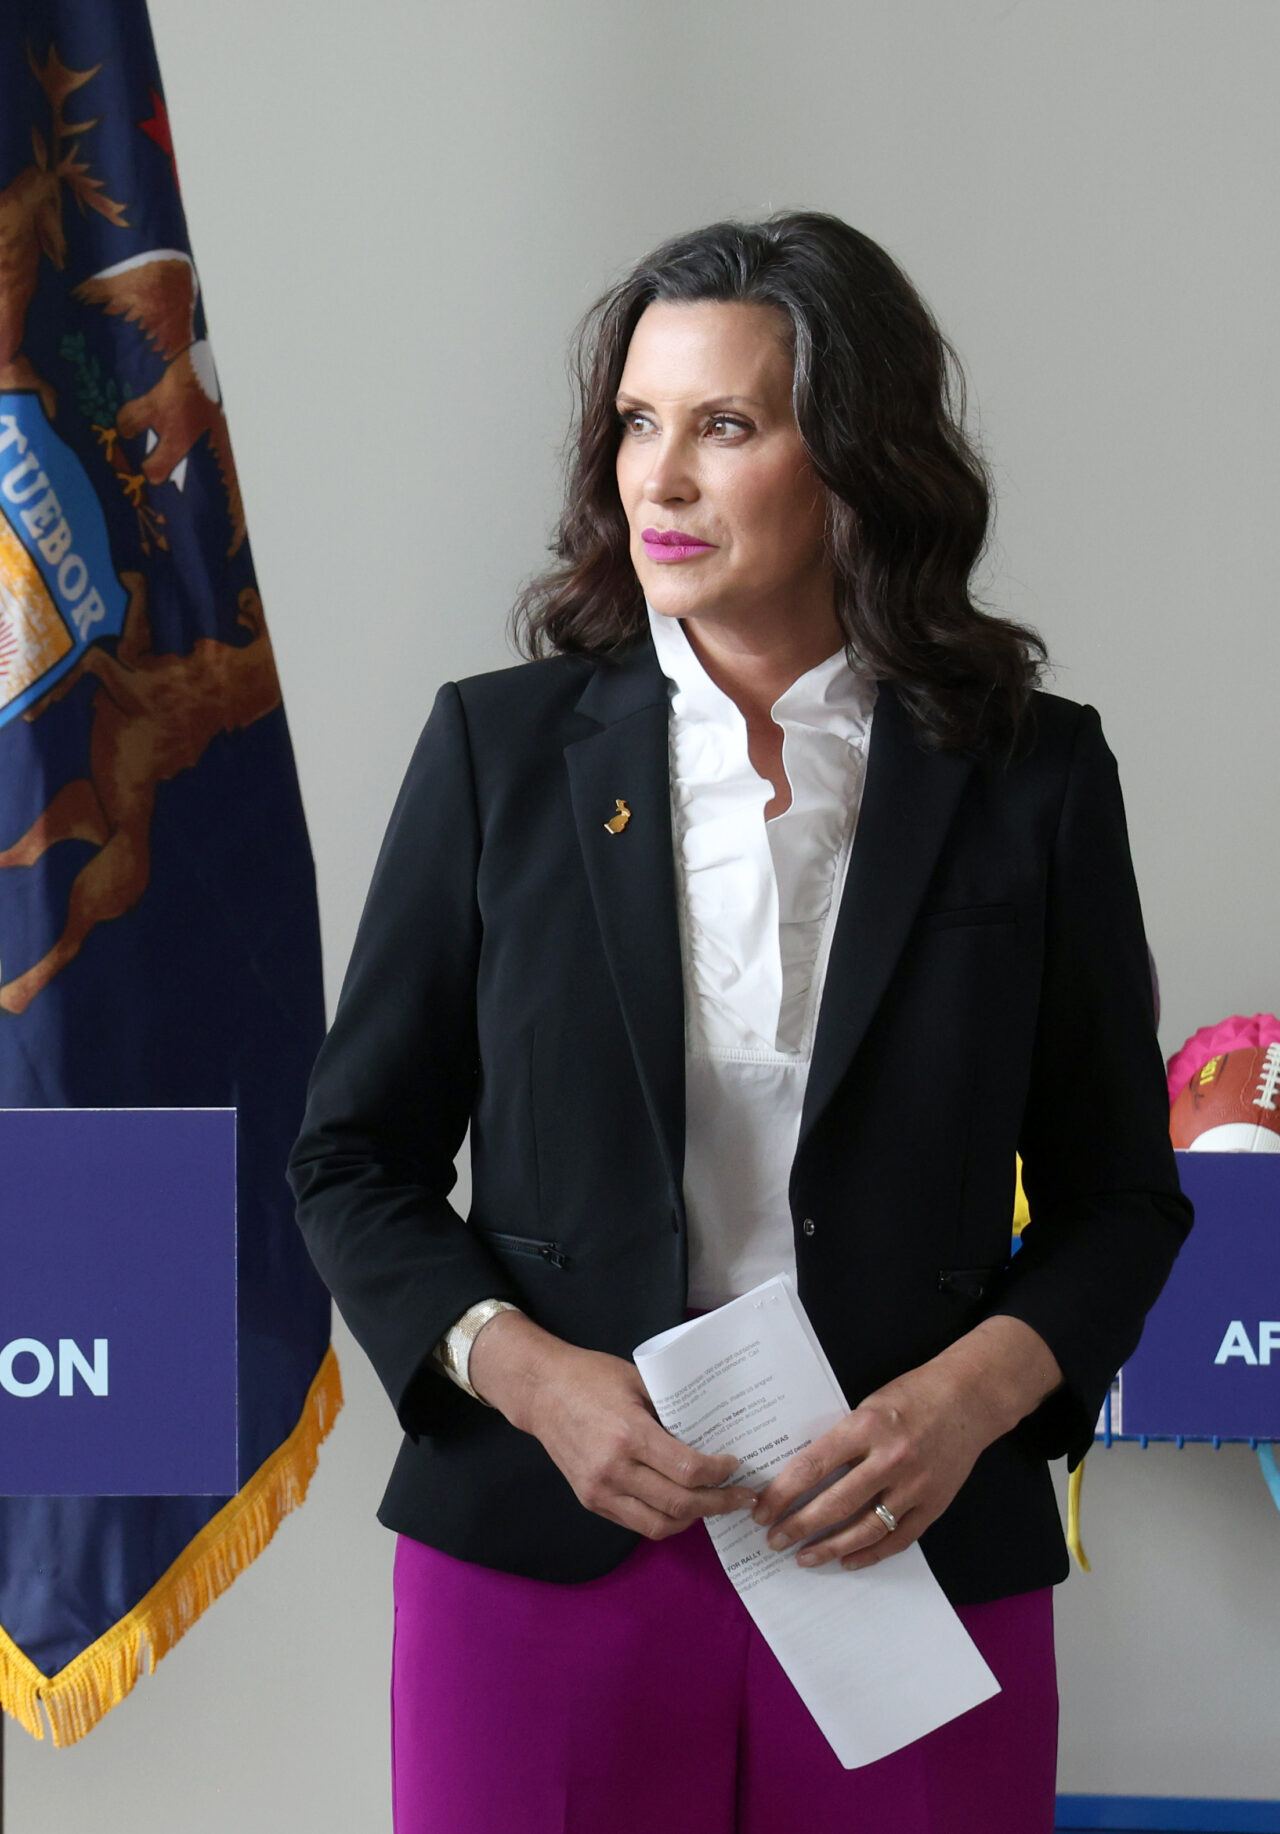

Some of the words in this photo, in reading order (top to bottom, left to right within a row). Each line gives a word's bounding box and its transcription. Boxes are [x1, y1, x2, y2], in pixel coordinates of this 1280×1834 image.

[1214, 1320, 1280, 1366] AF
[737, 1449, 759, 1464] STING
[758, 1441, 774, 1453] THIS
[772, 1434, 789, 1446] WAS
[739, 1549, 762, 1565] RALLY
